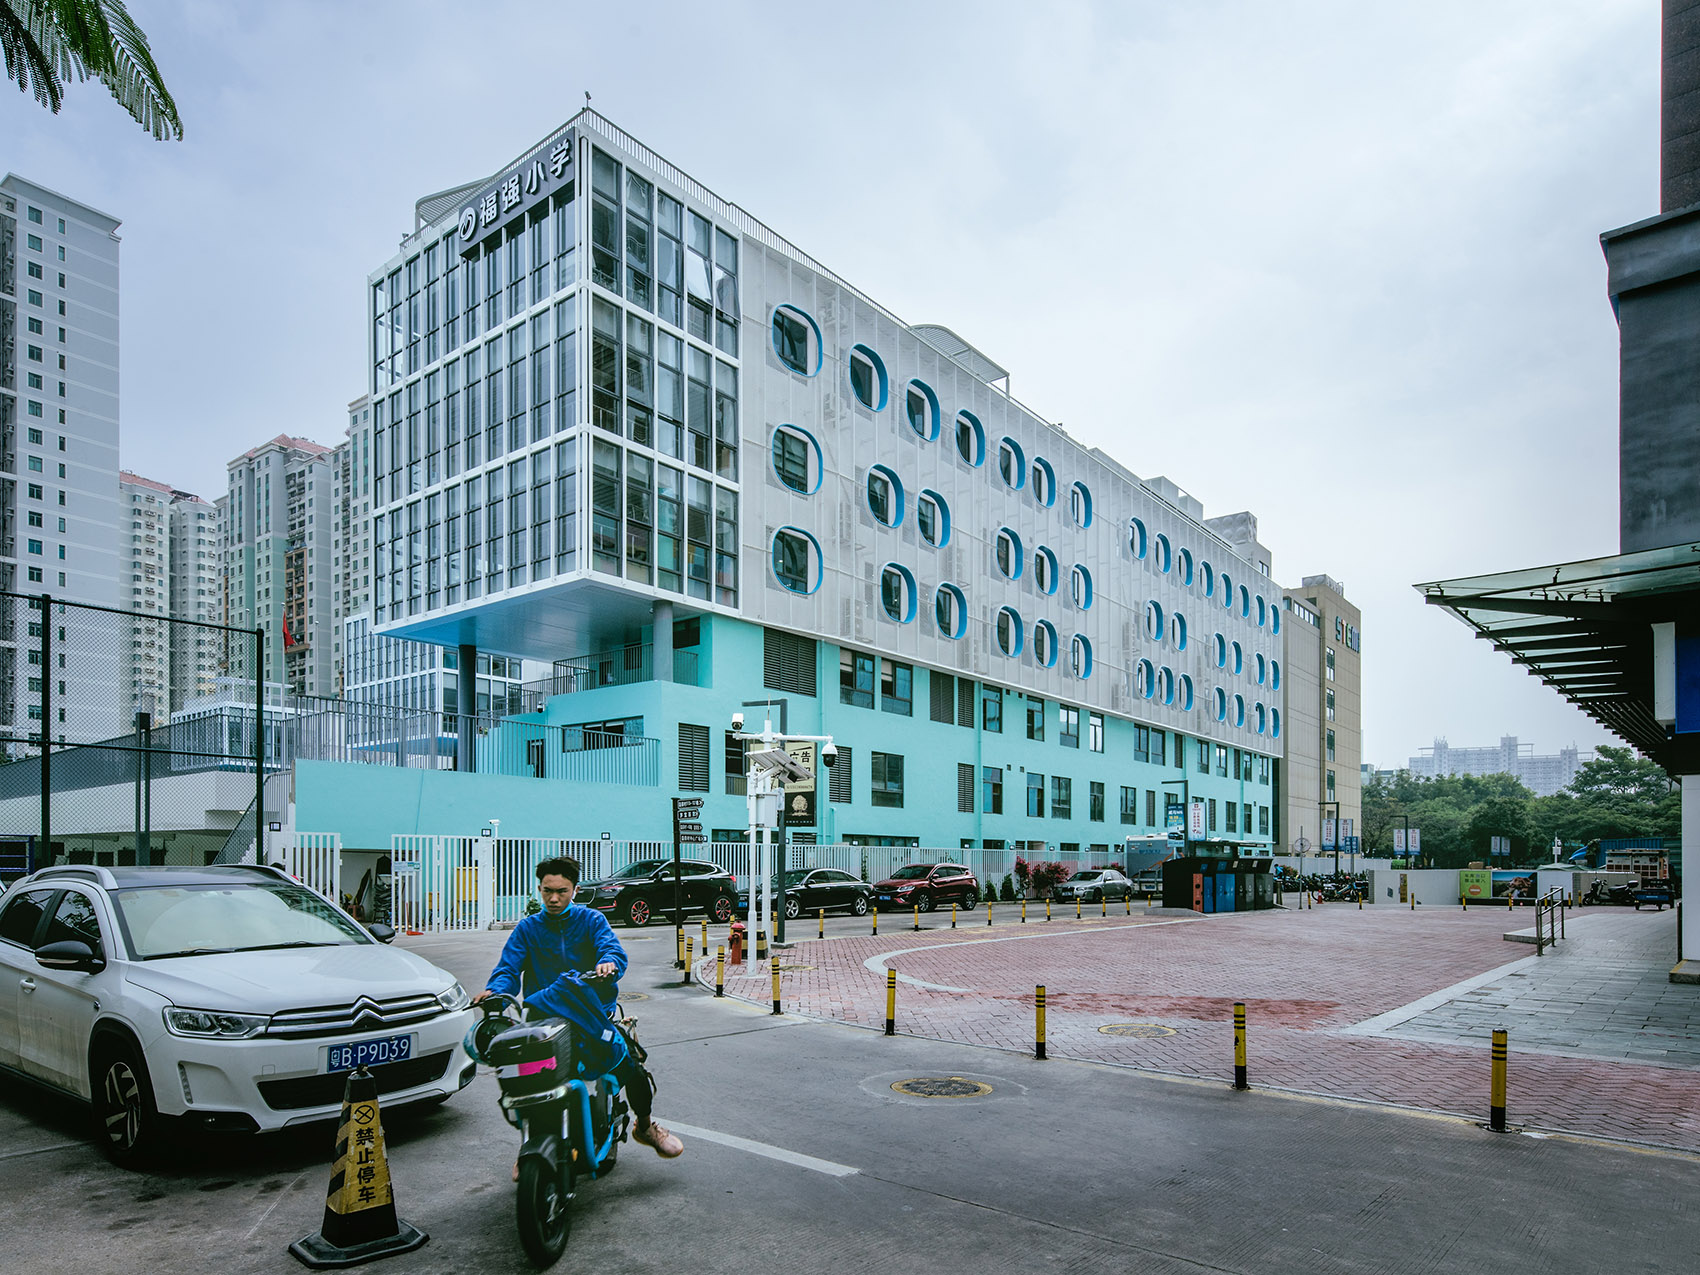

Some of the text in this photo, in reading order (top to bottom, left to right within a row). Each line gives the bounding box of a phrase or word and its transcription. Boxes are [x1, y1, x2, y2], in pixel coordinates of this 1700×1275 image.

[480, 138, 571, 228] 福强小学
[355, 1127, 376, 1203] 禁止停车
